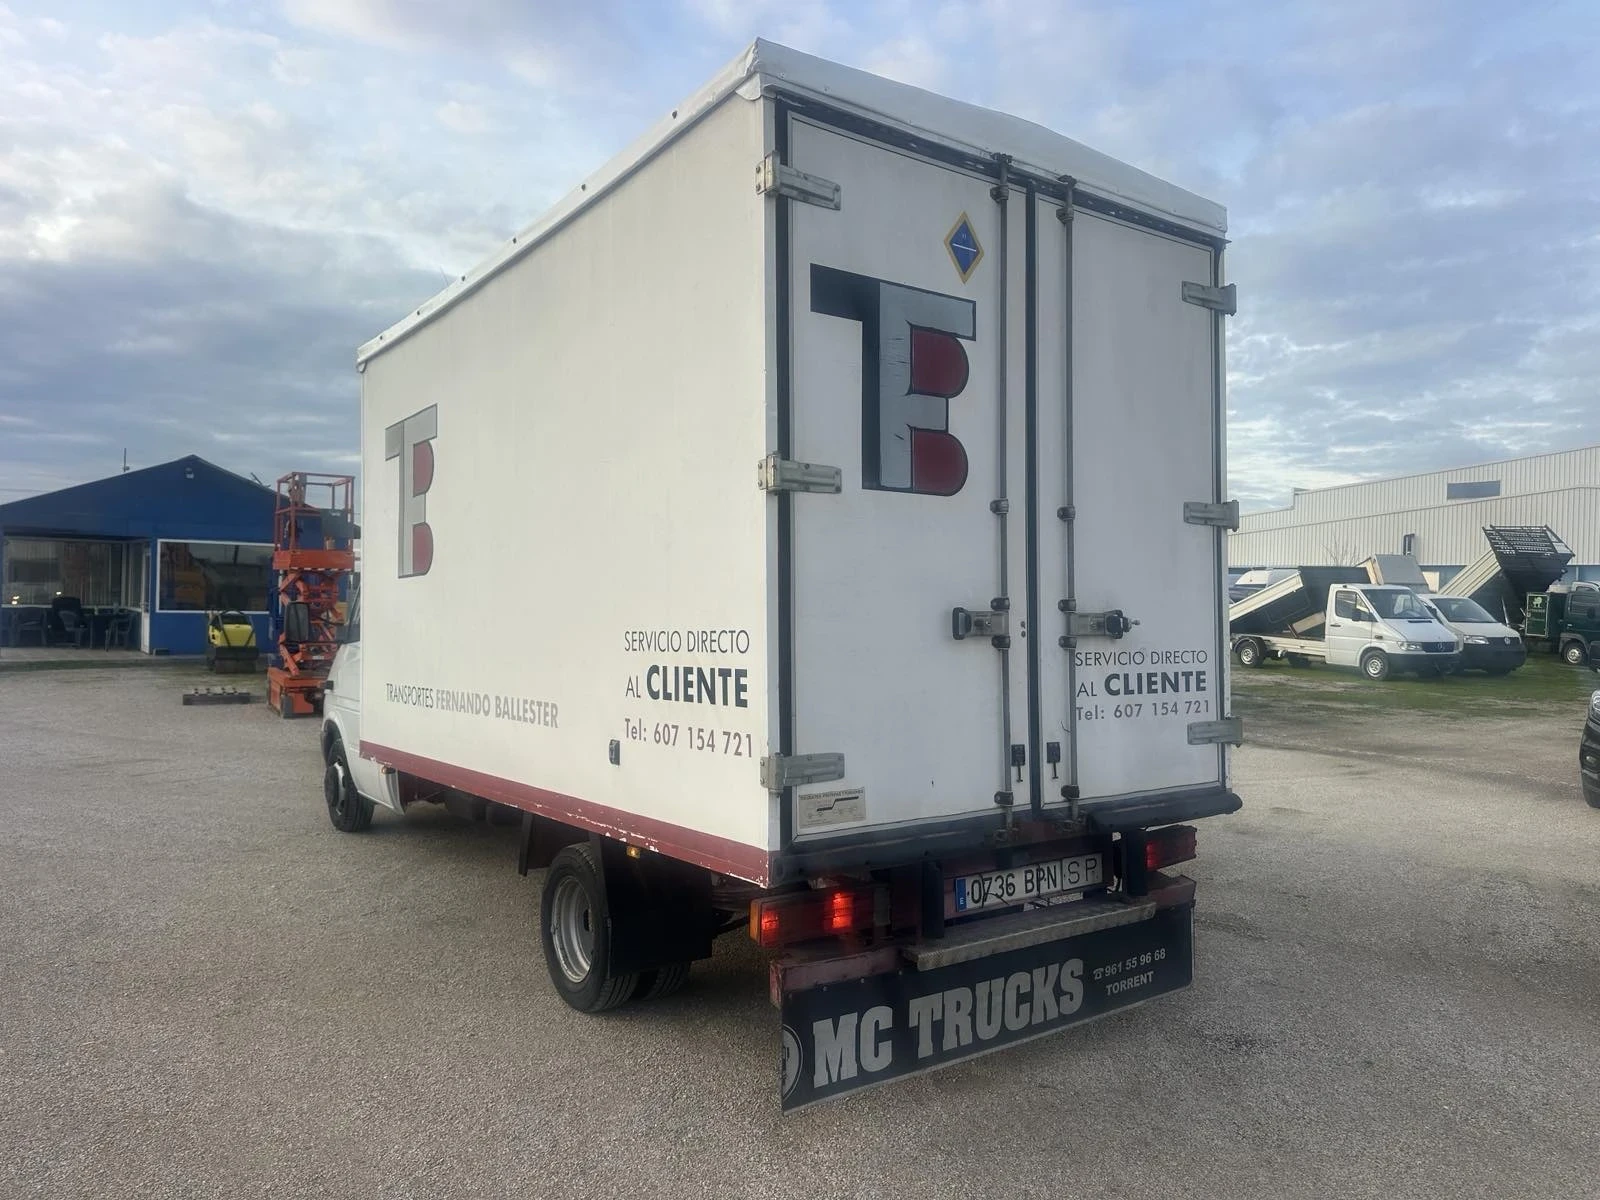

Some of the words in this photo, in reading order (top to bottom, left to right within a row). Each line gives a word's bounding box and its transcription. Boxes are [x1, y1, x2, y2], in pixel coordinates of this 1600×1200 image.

[624, 630, 682, 653] SERVICIO
[687, 629, 750, 654] DIRECTO
[1075, 650, 1145, 667] SERVICIO
[1150, 650, 1208, 665] DIRECTO
[625, 675, 641, 699] AL
[646, 664, 748, 708] CLIENTE
[1076, 681, 1098, 698] AL
[1104, 670, 1207, 696] CLIENTE
[386, 683, 434, 709] TRANSPORTES
[436, 688, 491, 717] FERNANDO
[495, 696, 559, 729] BALLESTER
[1075, 704, 1105, 721] Tel:
[1113, 703, 1143, 719] 607
[1152, 701, 1178, 717] 154
[1184, 699, 1209, 714] 721
[624, 717, 647, 742] Tel:
[654, 722, 679, 747] 607
[688, 726, 716, 753] 154
[722, 731, 752, 758] 721
[970, 873, 1016, 904] 0736
[1024, 865, 1057, 895] BPN
[1104, 962, 1122, 977] 961
[1125, 956, 1138, 970] 55
[1140, 952, 1152, 966] 96
[1154, 947, 1166, 960] 68
[1105, 970, 1154, 996] TORRENT
[812, 1005, 893, 1088] MC
[909, 958, 1085, 1059] TRUCKS
